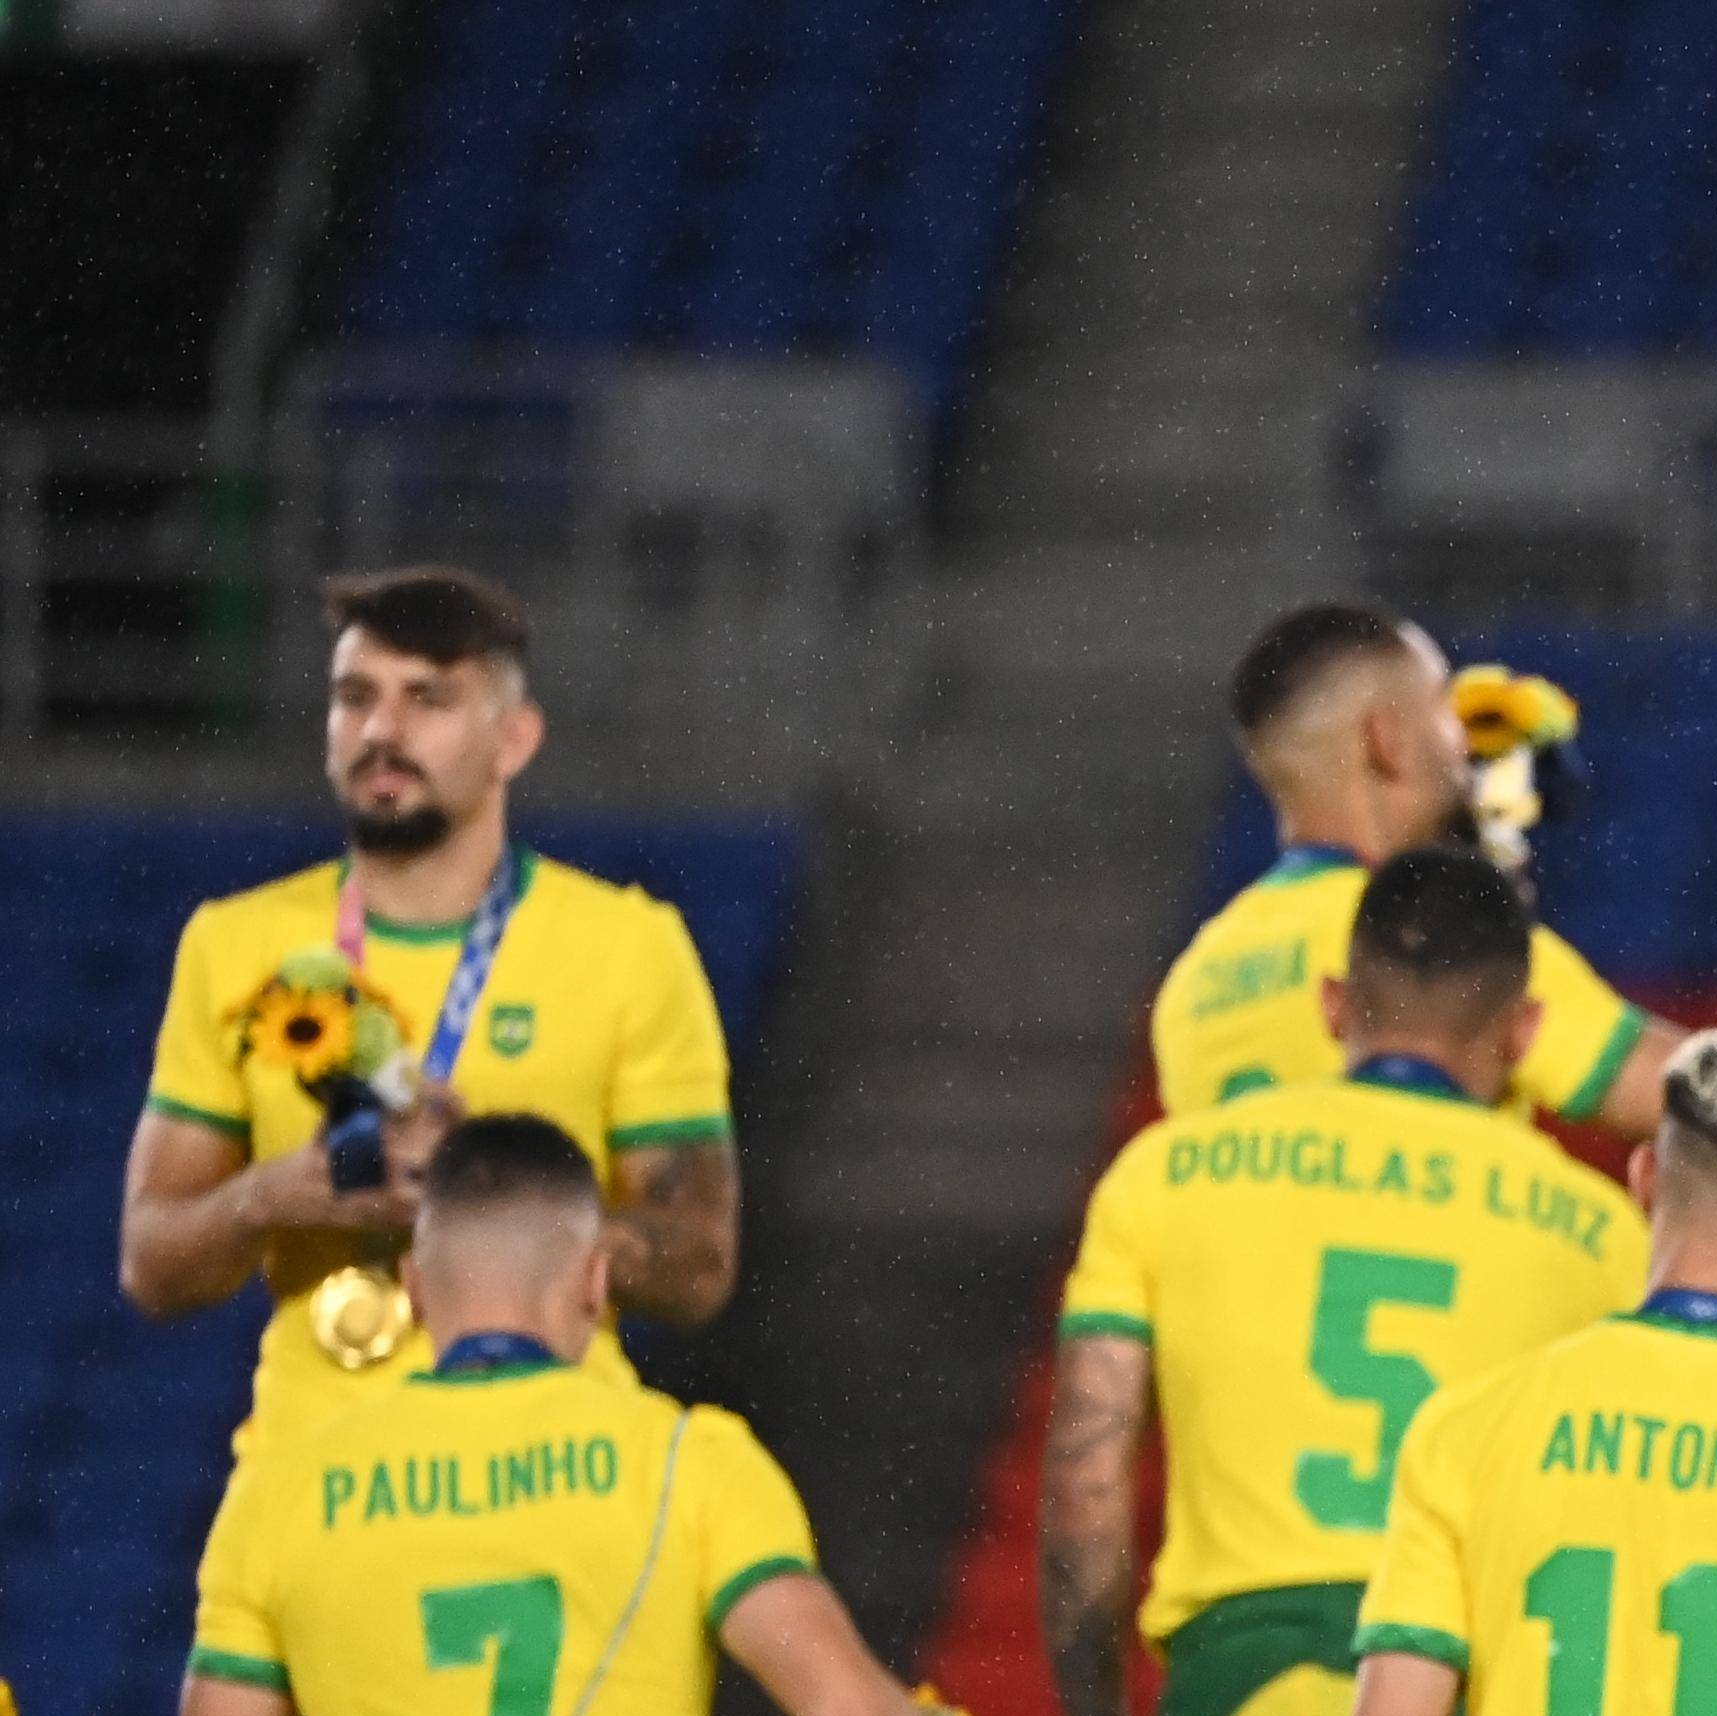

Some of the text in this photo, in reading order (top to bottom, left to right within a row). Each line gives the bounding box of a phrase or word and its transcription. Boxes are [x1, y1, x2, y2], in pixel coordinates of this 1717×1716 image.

[1166, 1130, 1612, 1260] DOUGLAS LUIZ
[1294, 1246, 1459, 1530] 5
[322, 1437, 619, 1529] PAULINHO
